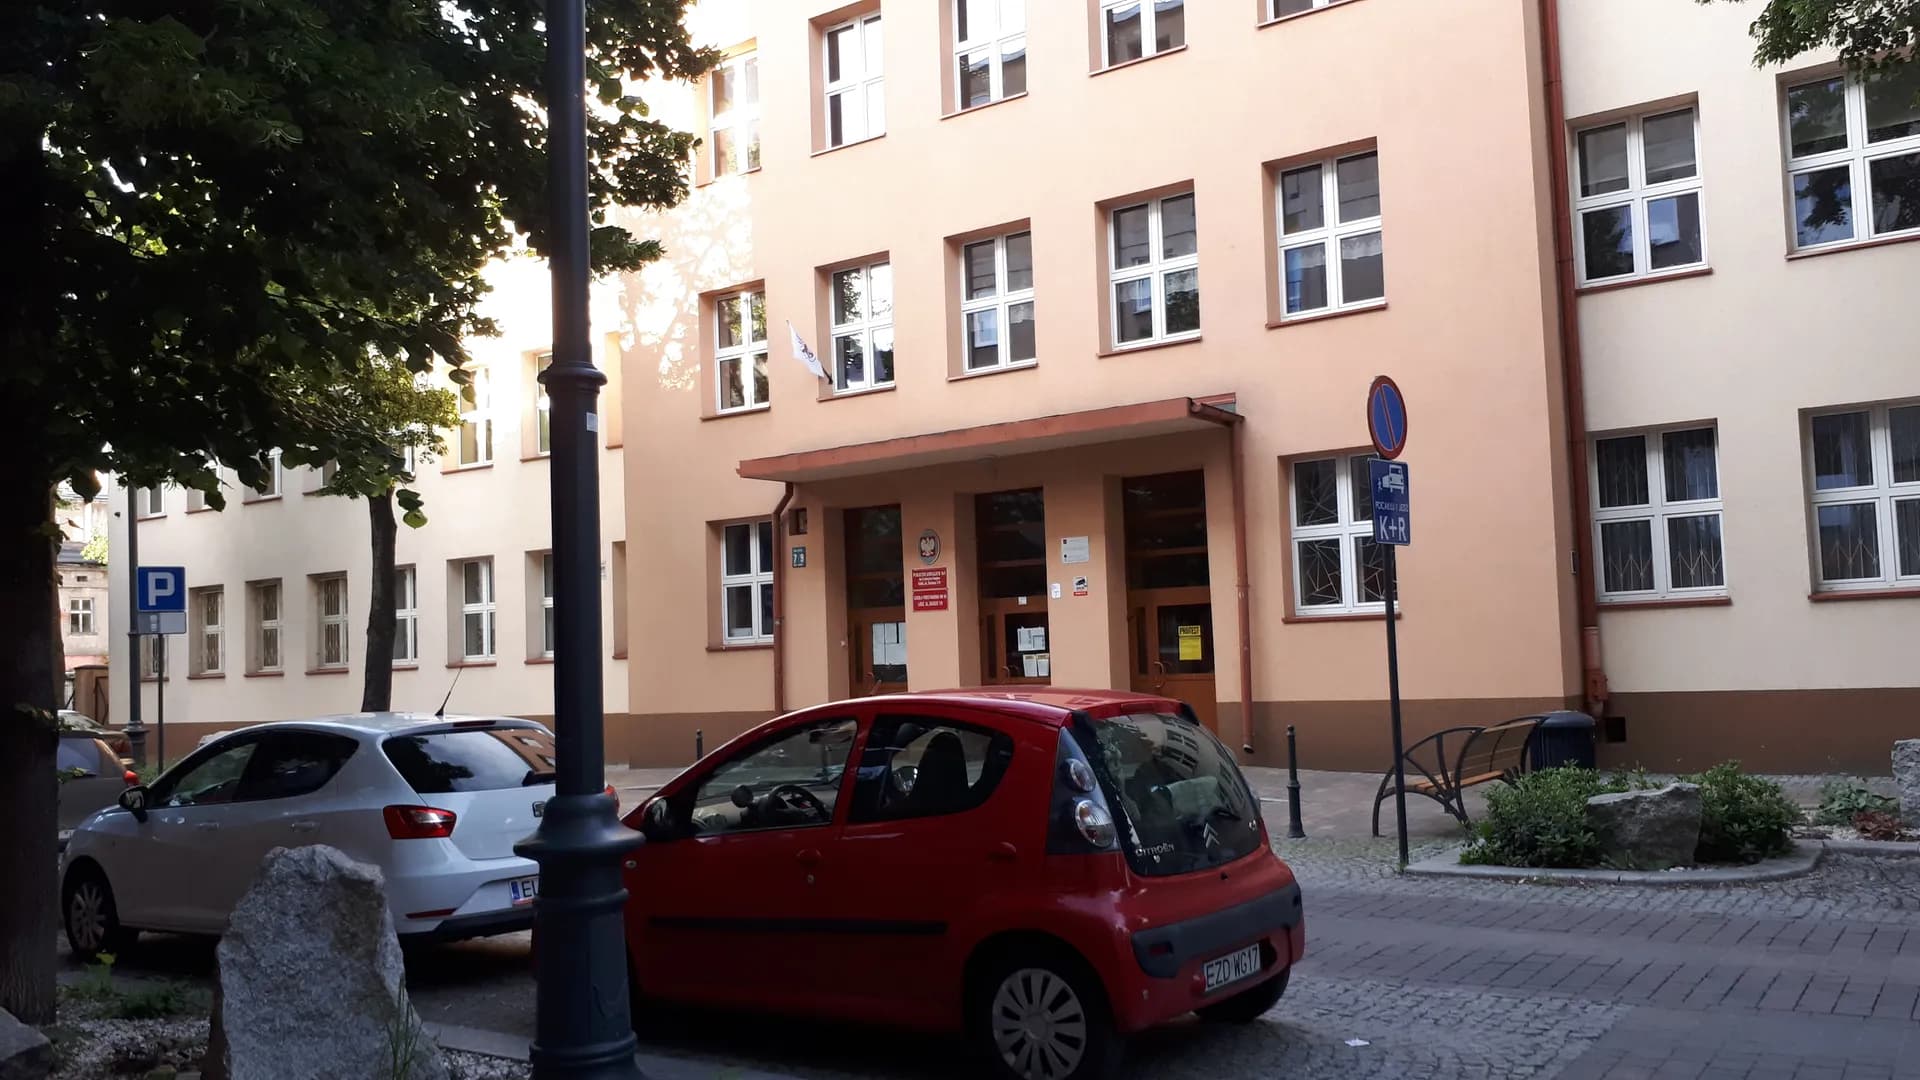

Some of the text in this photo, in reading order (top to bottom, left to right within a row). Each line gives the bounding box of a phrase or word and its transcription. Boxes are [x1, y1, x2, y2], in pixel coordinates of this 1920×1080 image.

[1379, 515, 1407, 542] K+R
[147, 571, 175, 606] P
[1206, 947, 1258, 987] EZD WG17
